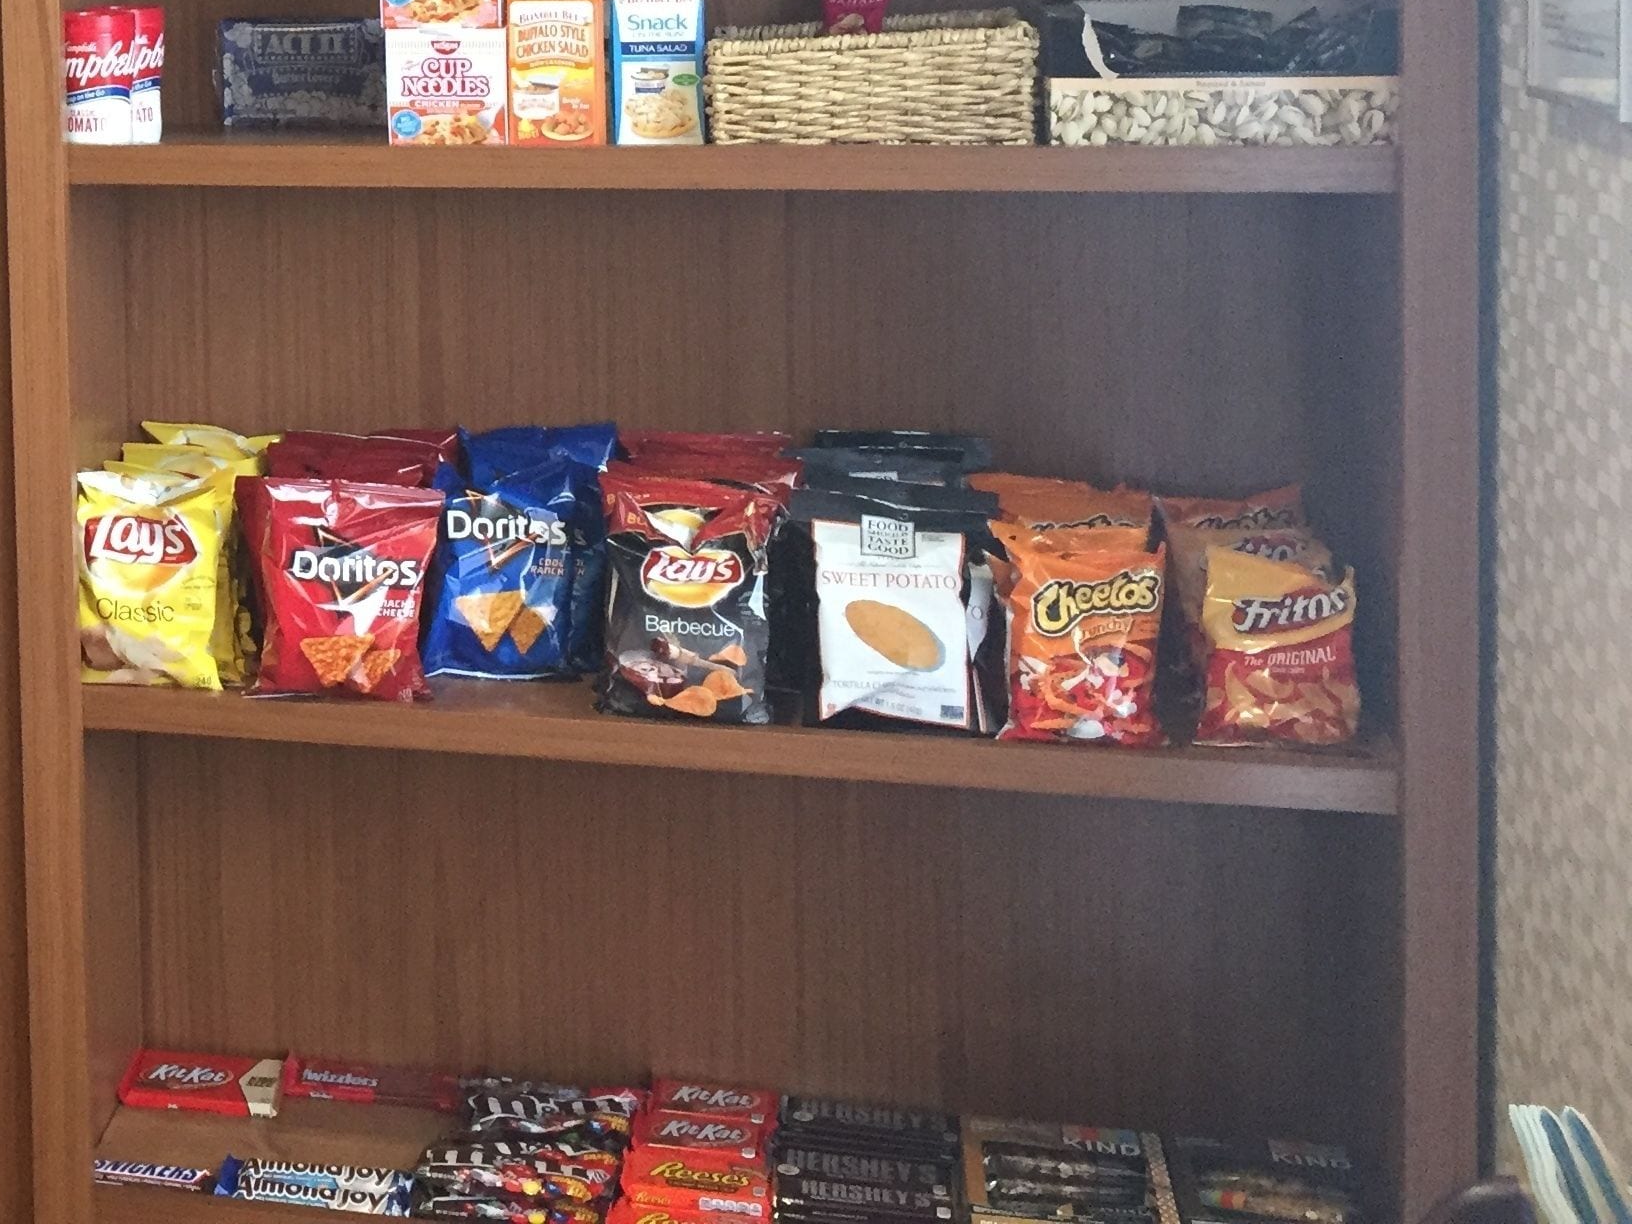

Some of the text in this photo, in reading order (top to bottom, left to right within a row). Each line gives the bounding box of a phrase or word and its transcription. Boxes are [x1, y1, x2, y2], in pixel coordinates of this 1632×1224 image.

[626, 13, 688, 31] Snack
[264, 32, 315, 55] ACT
[517, 24, 586, 43] BUFFALO STYLE
[515, 40, 589, 59] CHICKEN SALAD
[628, 43, 688, 52] TUNA SALAD
[421, 57, 473, 78] CUP
[401, 75, 491, 97] NOODLES
[447, 509, 567, 546] Doritos
[868, 519, 908, 532] FOOD
[867, 543, 909, 555] GOOD
[868, 536, 908, 546] TASTE
[292, 550, 417, 587] Doritos
[821, 571, 958, 590] SWEET POTATO
[96, 597, 175, 623] Classic
[1035, 575, 1156, 632] Cheetos
[1234, 587, 1346, 632] Fritos
[645, 614, 735, 637] Barbecue
[1244, 645, 1336, 666] The ORIGINAL
[1062, 1136, 1141, 1157] KIND
[1271, 1151, 1352, 1170] KIND
[238, 1174, 336, 1202] Almond
